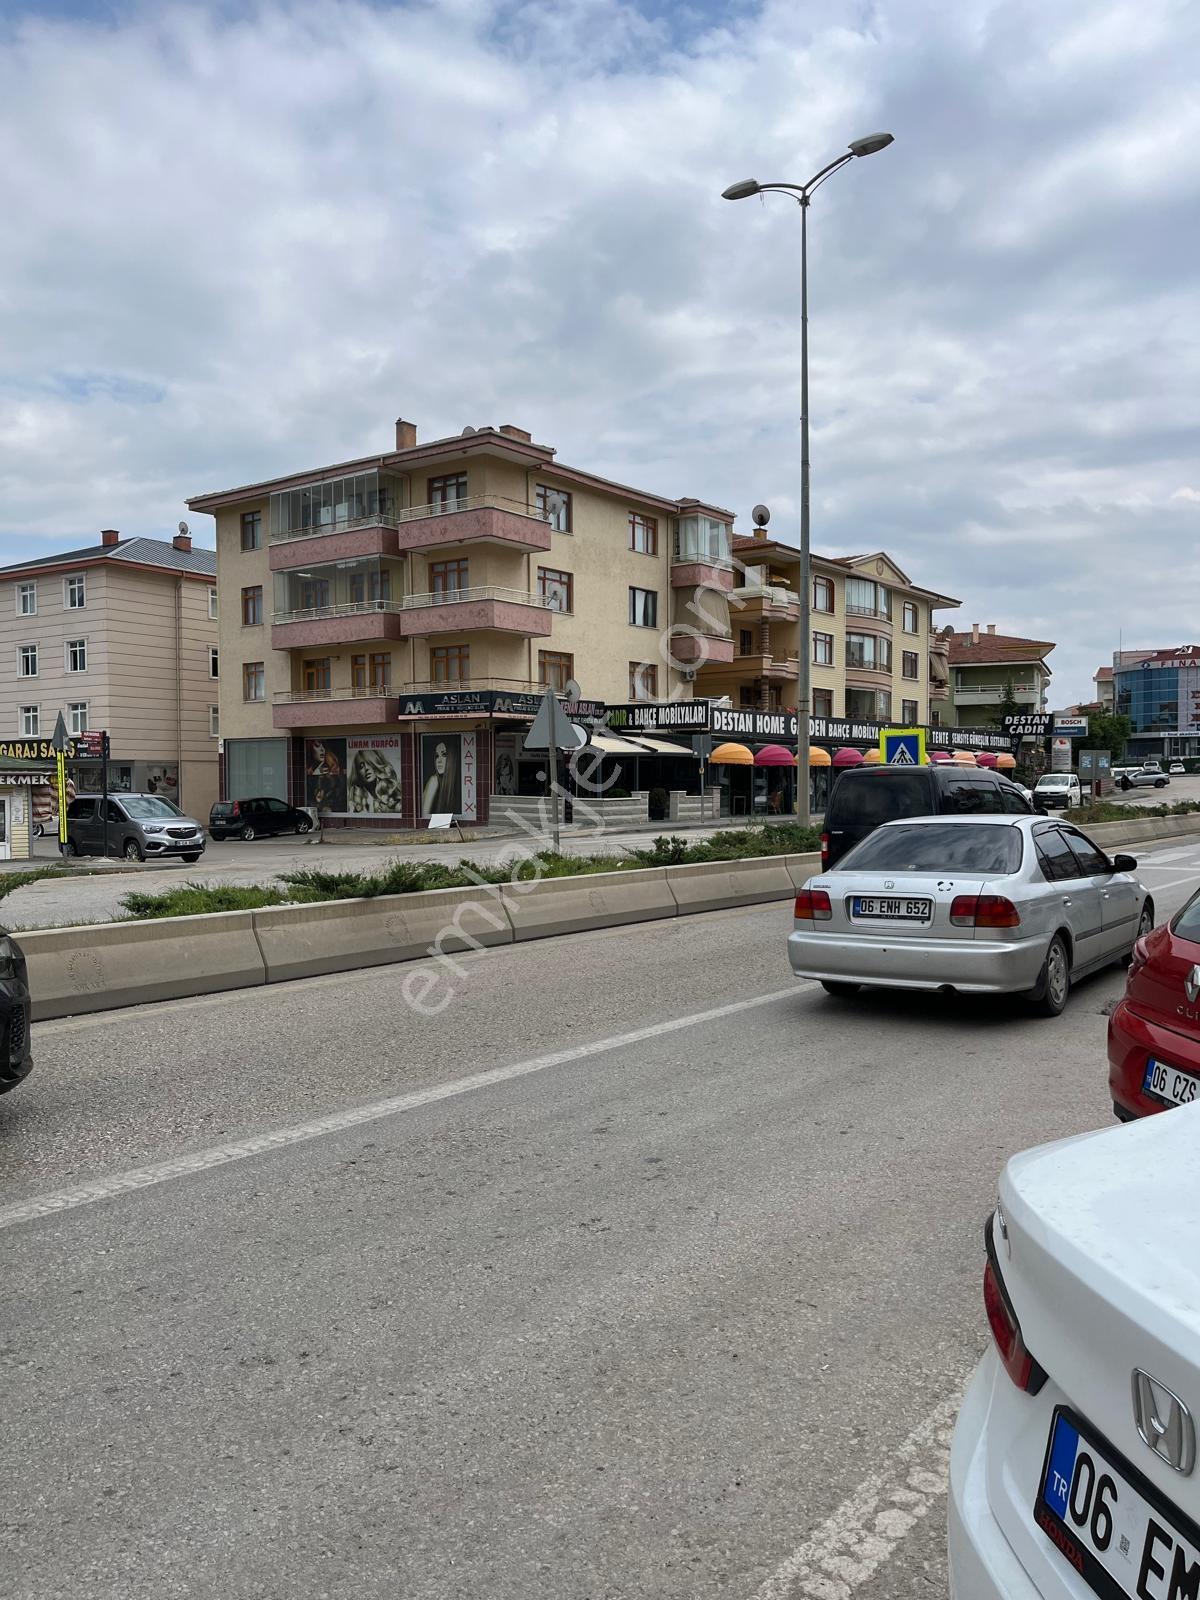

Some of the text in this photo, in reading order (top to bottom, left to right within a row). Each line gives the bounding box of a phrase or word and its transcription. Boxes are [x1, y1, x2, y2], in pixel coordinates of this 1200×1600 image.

[441, 693, 480, 704] ASLAN
[518, 695, 546, 706] ASL
[634, 708, 657, 728] BAHÇE
[658, 704, 706, 725] MOBİLYALARI
[713, 711, 879, 740] DESTAN HOME GDEN BAHÇE MOBİLYA
[1004, 715, 1050, 725] DESTAN
[932, 731, 949, 744] TENTE
[0, 741, 75, 759] GARAJ SAŞ
[463, 736, 474, 812] MATRIX
[860, 900, 874, 913] 06
[879, 901, 901, 914] ENH
[906, 902, 928, 915] 652
[1152, 1065, 1168, 1092] 06
[1053, 1470, 1068, 1502] TR
[1069, 1452, 1118, 1552] 06
[1038, 1511, 1084, 1572] HONDA
